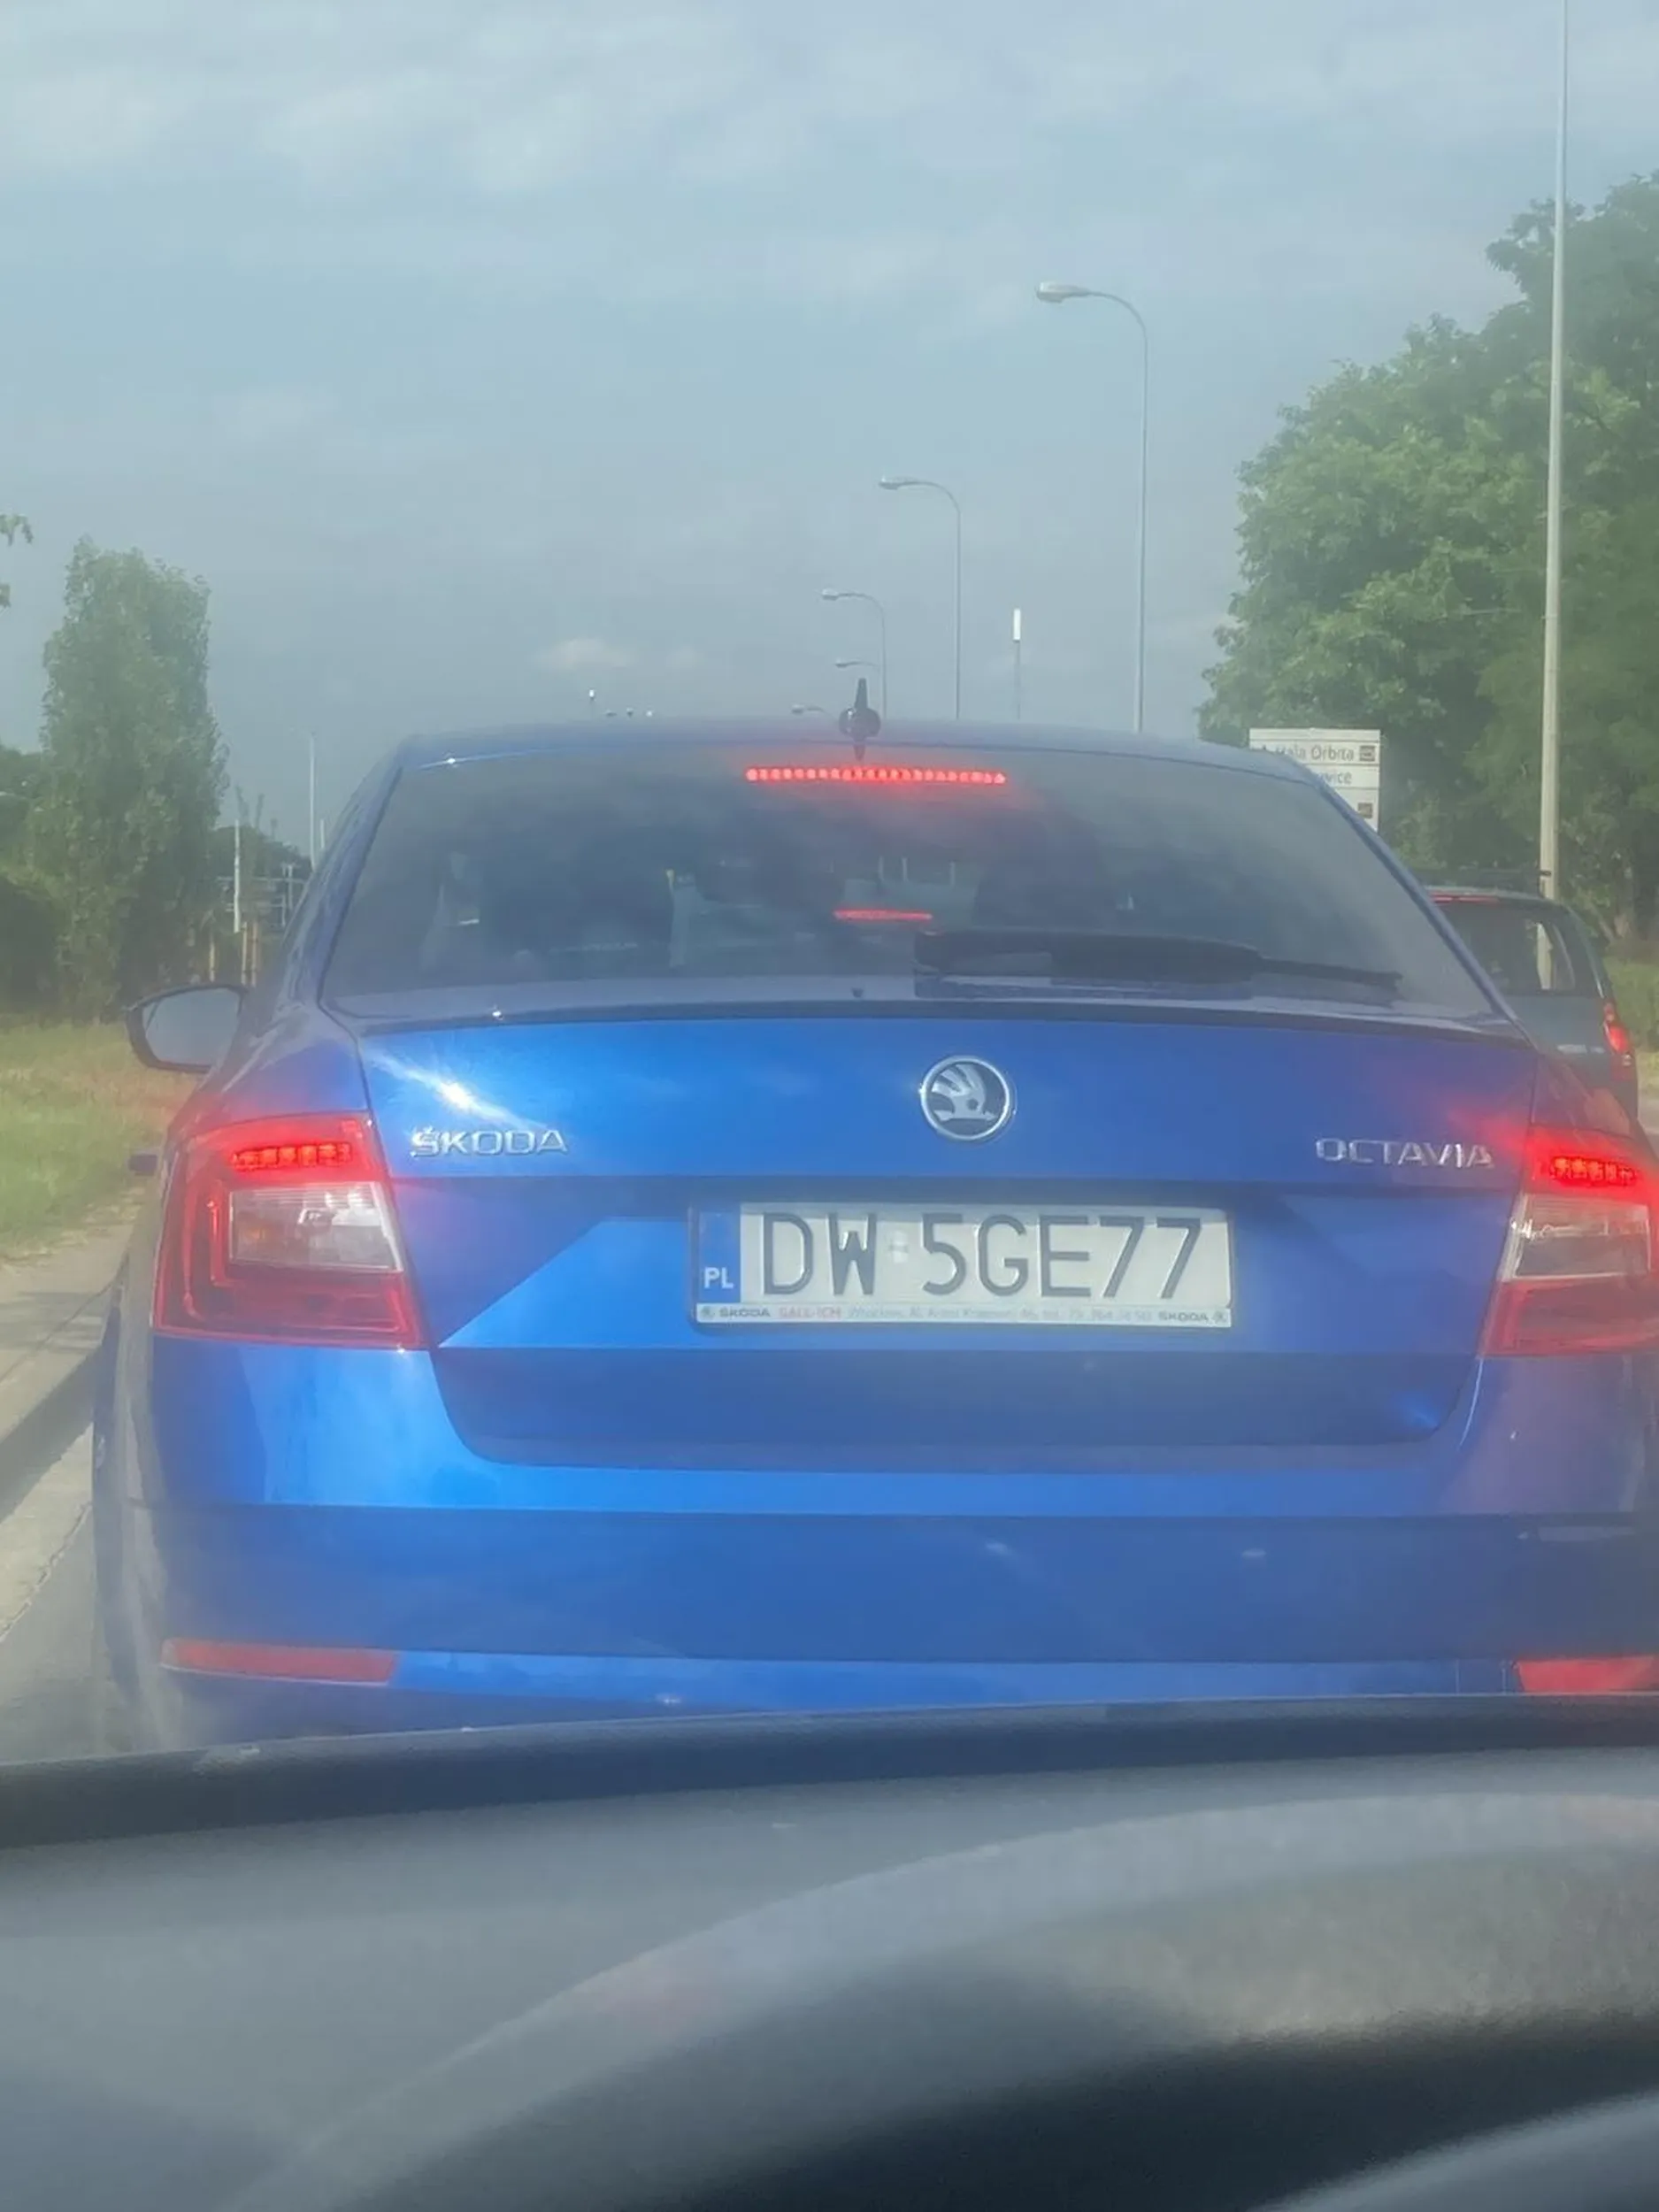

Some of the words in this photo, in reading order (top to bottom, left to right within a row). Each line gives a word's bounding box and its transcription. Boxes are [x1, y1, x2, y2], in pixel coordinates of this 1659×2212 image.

[1316, 1138, 1494, 1169] OCTAVIA
[763, 1212, 877, 1295] DW
[922, 1213, 1202, 1299] 5GE77
[704, 1267, 733, 1288] PL
